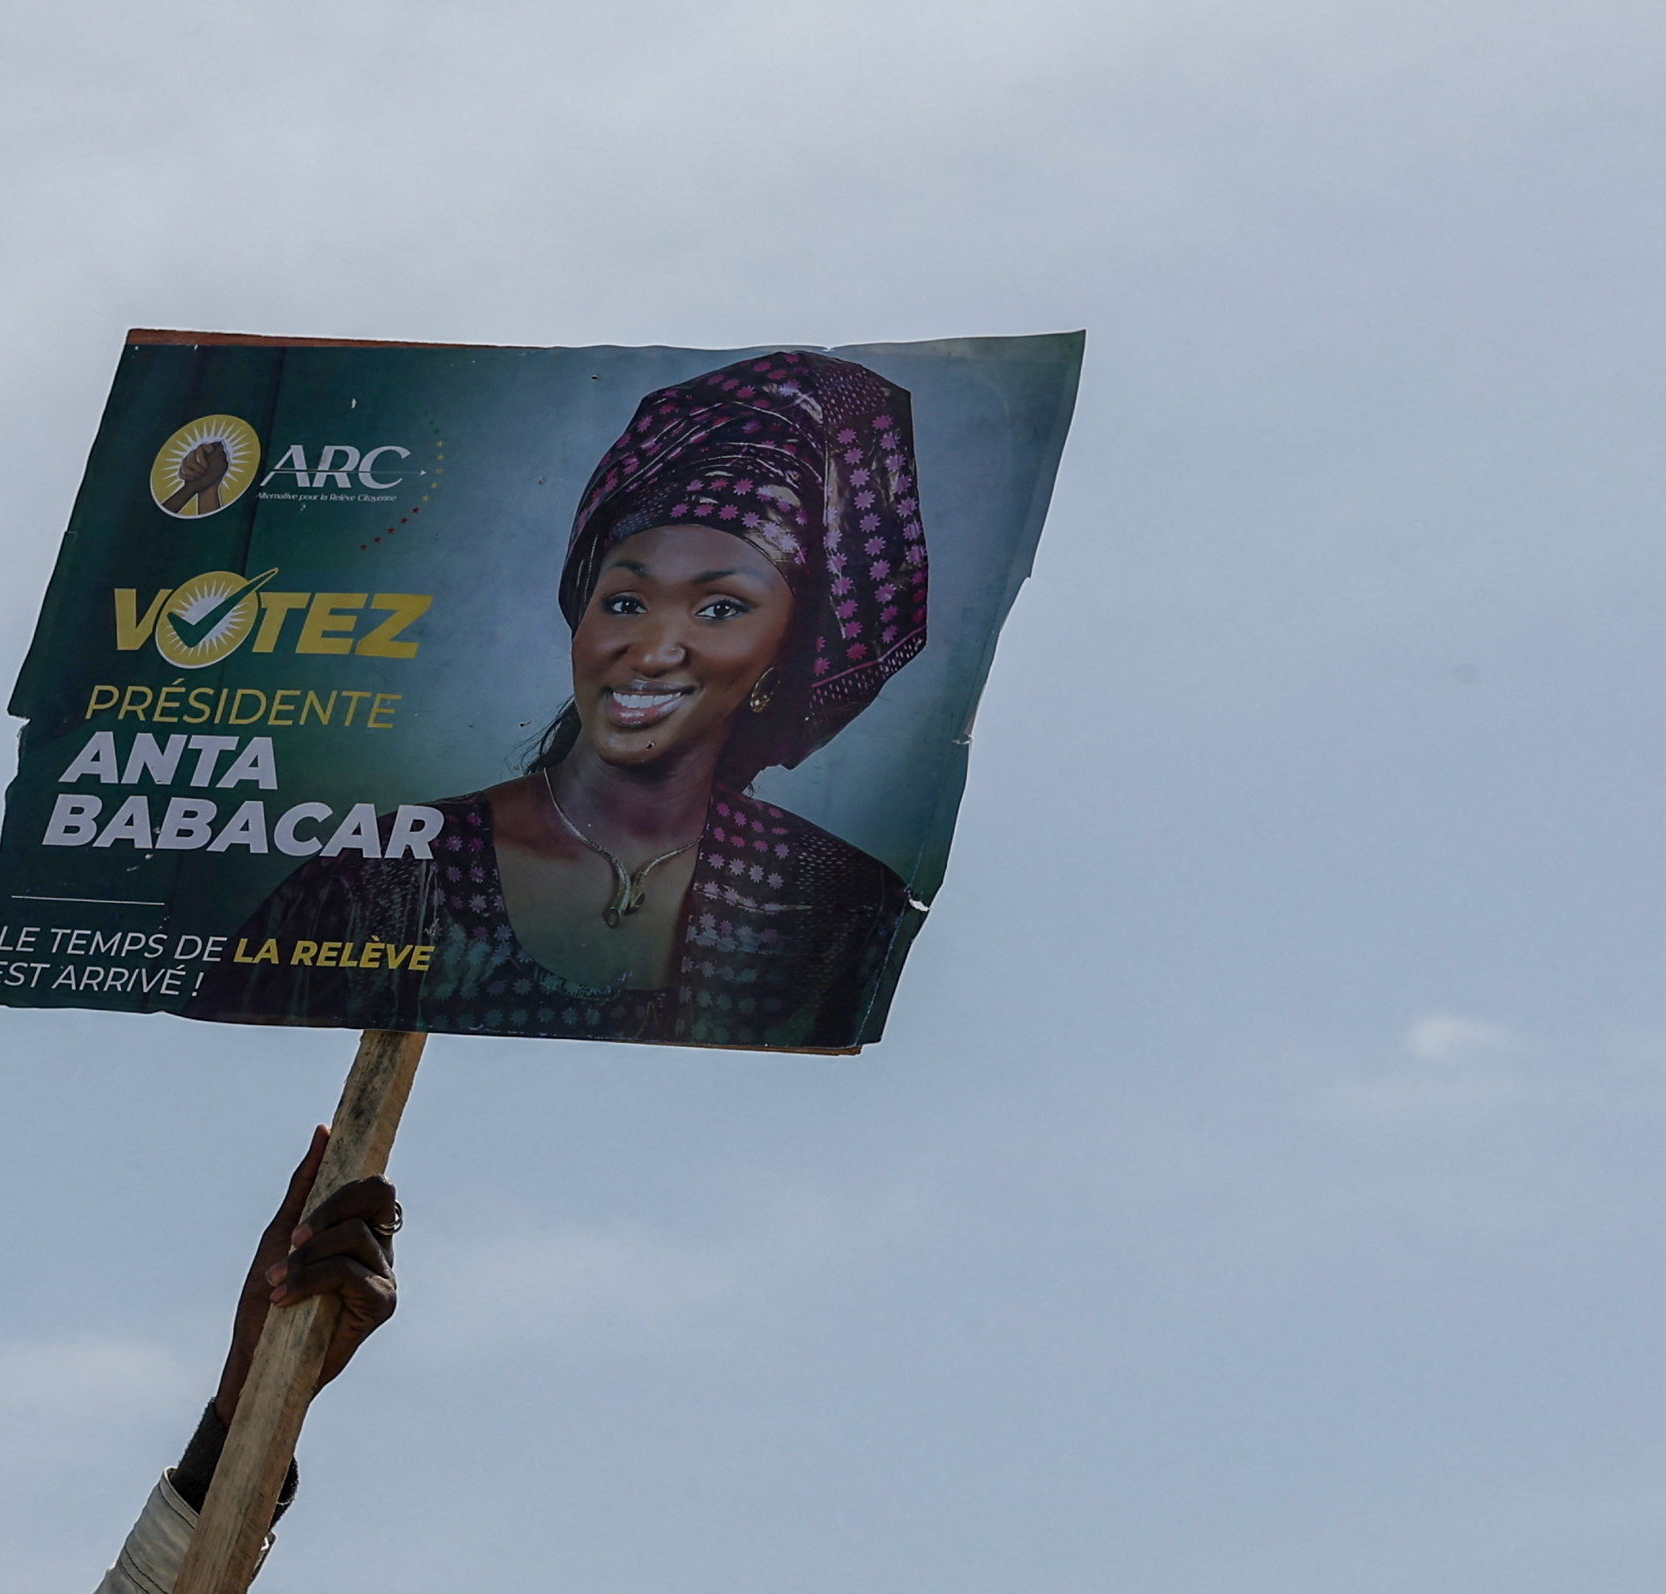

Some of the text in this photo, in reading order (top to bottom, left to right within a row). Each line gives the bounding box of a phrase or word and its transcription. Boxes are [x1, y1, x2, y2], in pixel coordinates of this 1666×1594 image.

[259, 444, 412, 490] ARC
[113, 568, 433, 669] VOTEZ
[85, 677, 404, 730] PRÉSIDENTE
[58, 730, 279, 790] ANTA
[41, 793, 445, 860] BABACAR
[49, 927, 167, 960] TEMPS
[174, 934, 228, 963] DE
[232, 937, 280, 965] LA
[290, 934, 436, 972] RELÈVE
[53, 965, 188, 997] ARRIVÉ
